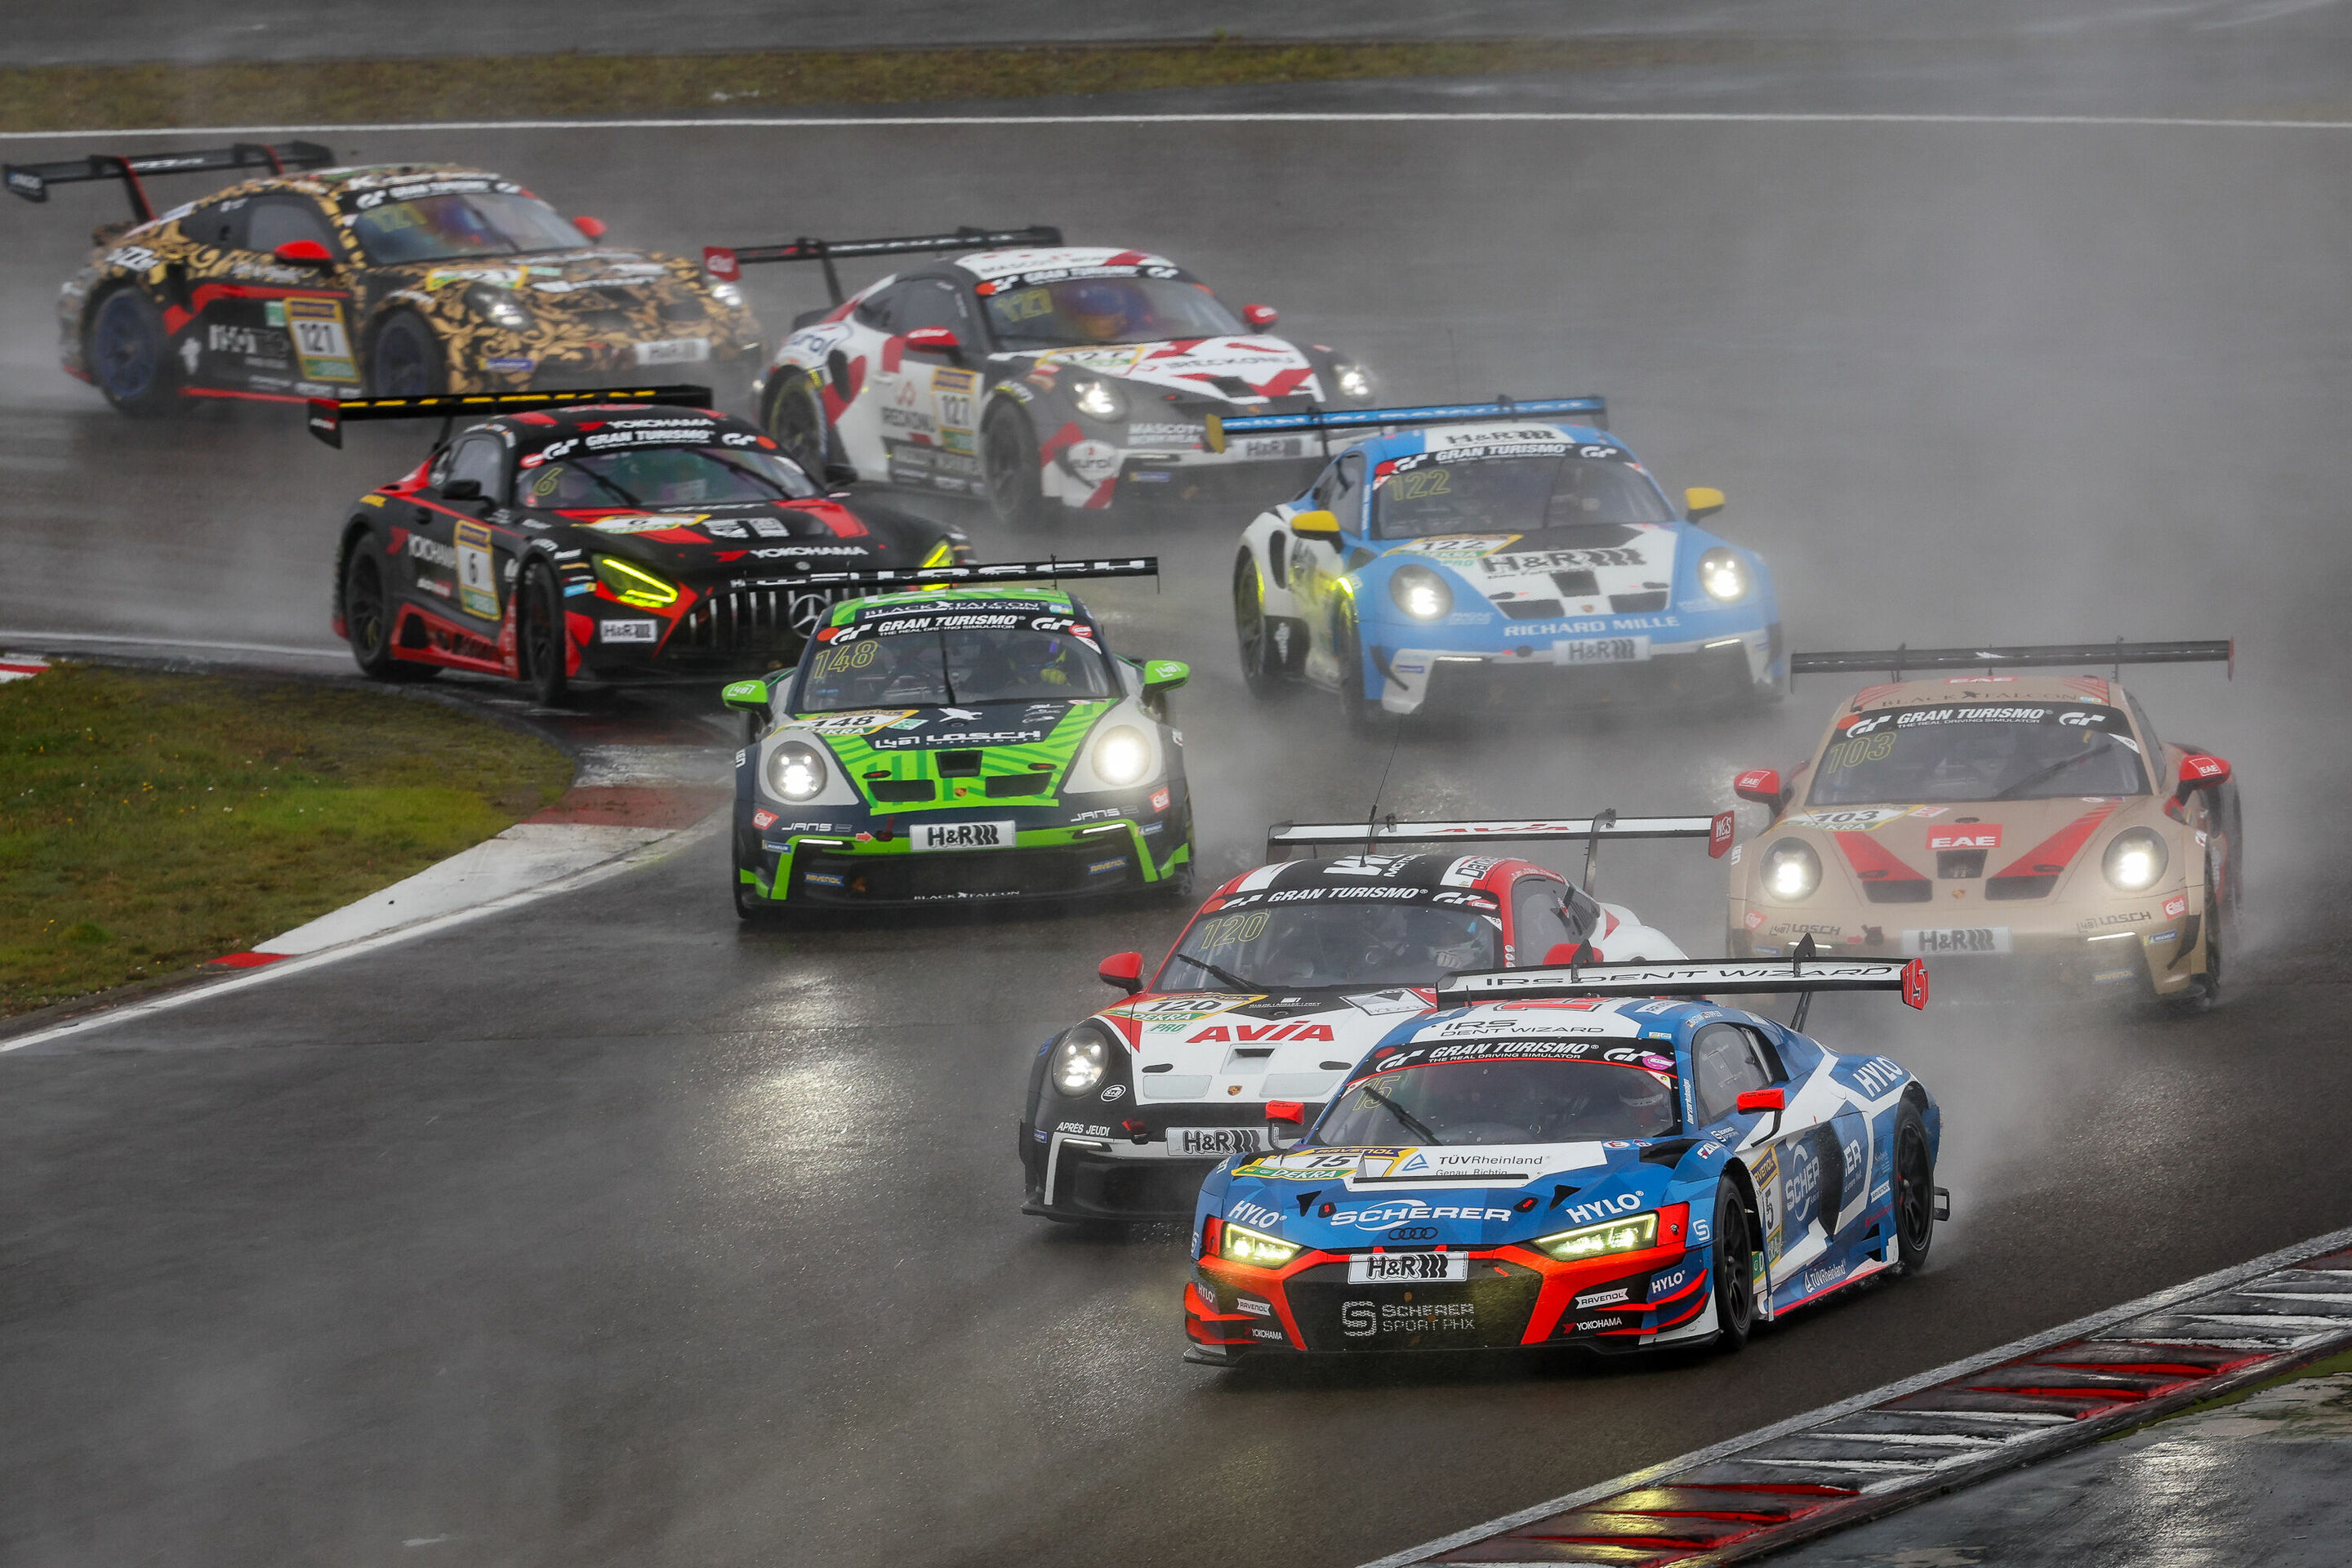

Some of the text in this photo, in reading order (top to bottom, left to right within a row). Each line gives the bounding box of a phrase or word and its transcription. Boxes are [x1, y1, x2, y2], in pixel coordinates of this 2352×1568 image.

[607, 417, 715, 430] YOKOHAMA
[585, 429, 715, 448] GRAN TURISMO
[1435, 443, 1566, 461] GRAN TURISMO
[532, 467, 564, 497] 6
[1388, 469, 1451, 501] 122
[750, 546, 869, 559] YOKOHAMA
[469, 552, 479, 585] 6
[1481, 551, 1583, 573] H&R
[865, 600, 1040, 617] BLACK FALCON
[878, 615, 1018, 632] GRAN TURISMO
[1503, 618, 1606, 637] RICHARD
[1613, 615, 1682, 631] MILLE
[1568, 639, 1610, 661] H&R
[813, 640, 878, 679] 148
[1882, 691, 2078, 707] BLACK FALCON
[817, 715, 875, 728] 148
[1897, 707, 2046, 725] GRAN TURISMO
[926, 730, 1041, 742] LOSCH
[1826, 731, 1899, 774] 103
[1814, 809, 1880, 823] 103
[927, 826, 975, 849] H&R
[1931, 835, 1997, 849] EAE
[1267, 886, 1419, 902] GRAN TURISMO
[2100, 911, 2152, 925] LOSCH
[1201, 911, 1270, 950] 120
[1792, 924, 1842, 934] LOSCH
[1919, 929, 1967, 953] H&R
[1577, 970, 1708, 984] DENT
[1718, 964, 1895, 980] WIZARD
[1148, 999, 1223, 1013] 120
[1132, 1012, 1194, 1021] DEKRA
[1443, 1019, 1518, 1031] IRS
[1151, 1023, 1185, 1033] PRO
[1441, 1025, 1606, 1037] DENT WIZARD
[1428, 1041, 1591, 1058] GRAN TURISMO
[1521, 1052, 1582, 1060] SIMULATOR
[1853, 1055, 1904, 1098] HYLO
[1352, 1075, 1402, 1112] 15
[1085, 1124, 1111, 1138] JEUDI
[1183, 1130, 1232, 1154] H&R
[1314, 1147, 1395, 1156] RAVENOL
[1305, 1155, 1360, 1169] 15
[1270, 1169, 1339, 1181] DEKRA
[1228, 1200, 1281, 1229] HYLO
[1330, 1204, 1514, 1227] SCHERER
[1566, 1192, 1642, 1224] HYLO
[1366, 1254, 1422, 1281] H&R
[1651, 1272, 1683, 1294] HYLO
[1198, 1283, 1214, 1303] HYLO
[1581, 1291, 1624, 1306] RAVENOL
[1240, 1301, 1268, 1312] RAVENOL
[1382, 1303, 1475, 1318] SCHERER
[1383, 1317, 1476, 1332] SPORT PHX
[1576, 1316, 1623, 1331] YOKOHAMA
[1251, 1327, 1283, 1340] YOKOHAMA
